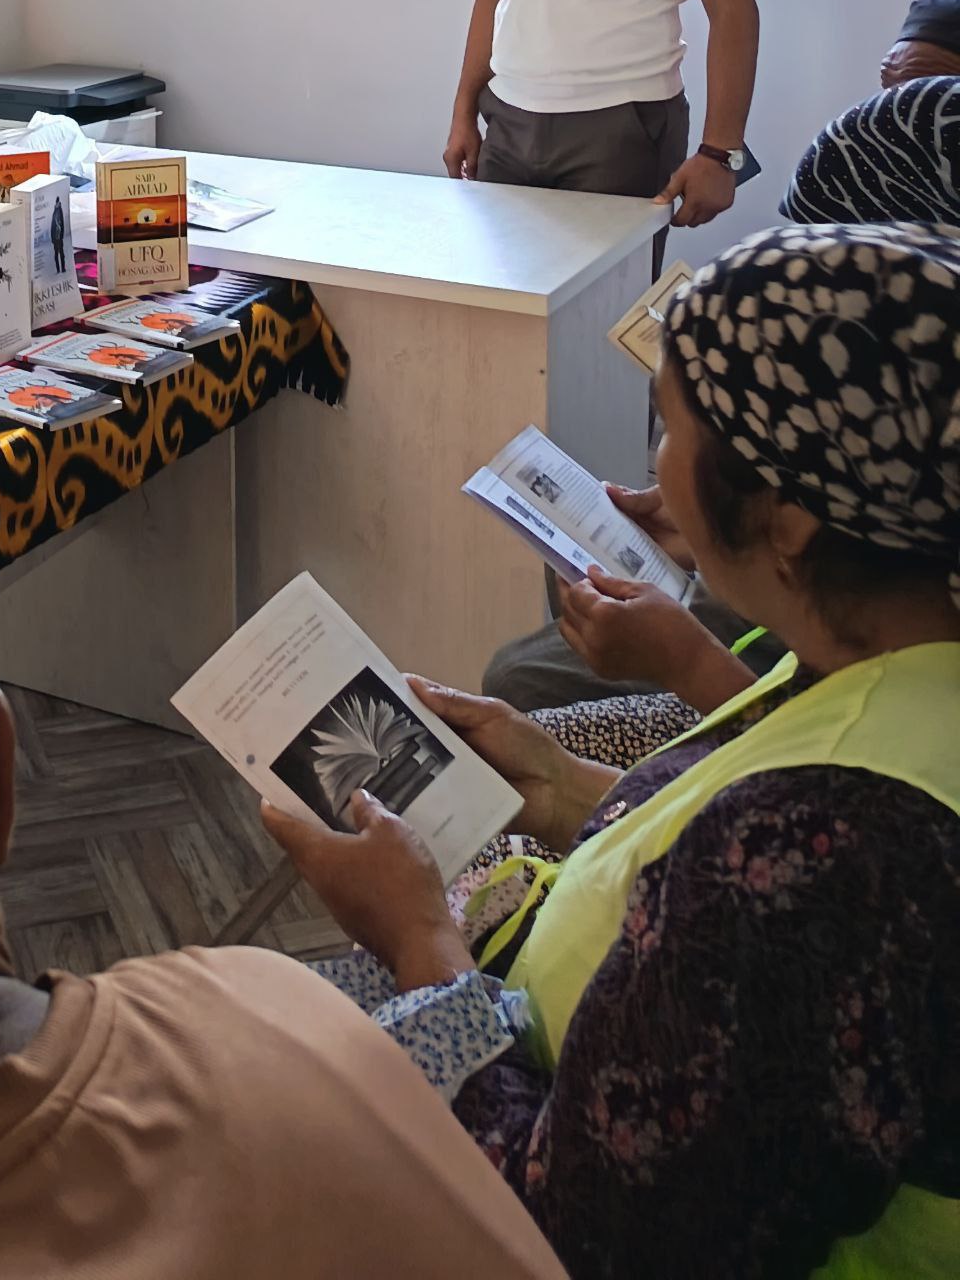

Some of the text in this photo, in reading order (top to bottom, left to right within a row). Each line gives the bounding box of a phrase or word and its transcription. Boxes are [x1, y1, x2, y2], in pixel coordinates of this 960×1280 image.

[135, 173, 156, 183] SAID
[125, 182, 168, 197] AHMAD
[129, 244, 166, 263] UFQ
